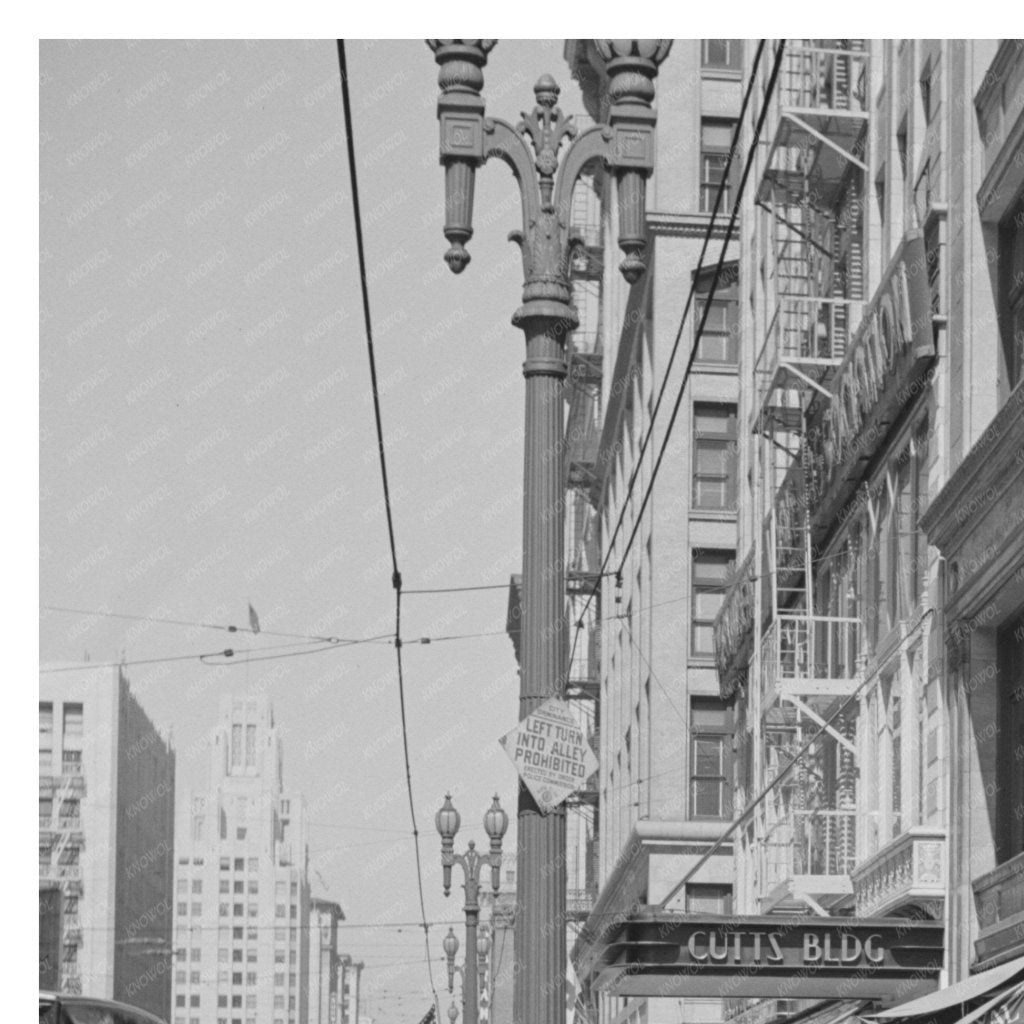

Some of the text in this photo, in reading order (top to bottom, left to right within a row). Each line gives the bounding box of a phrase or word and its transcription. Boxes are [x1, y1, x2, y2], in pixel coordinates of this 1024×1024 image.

[516, 732, 588, 762] INTO ALLEY
[525, 717, 583, 747] LEFT TURN
[514, 747, 586, 778] PROHIBITED
[688, 931, 886, 963] CUTTS BLDG
